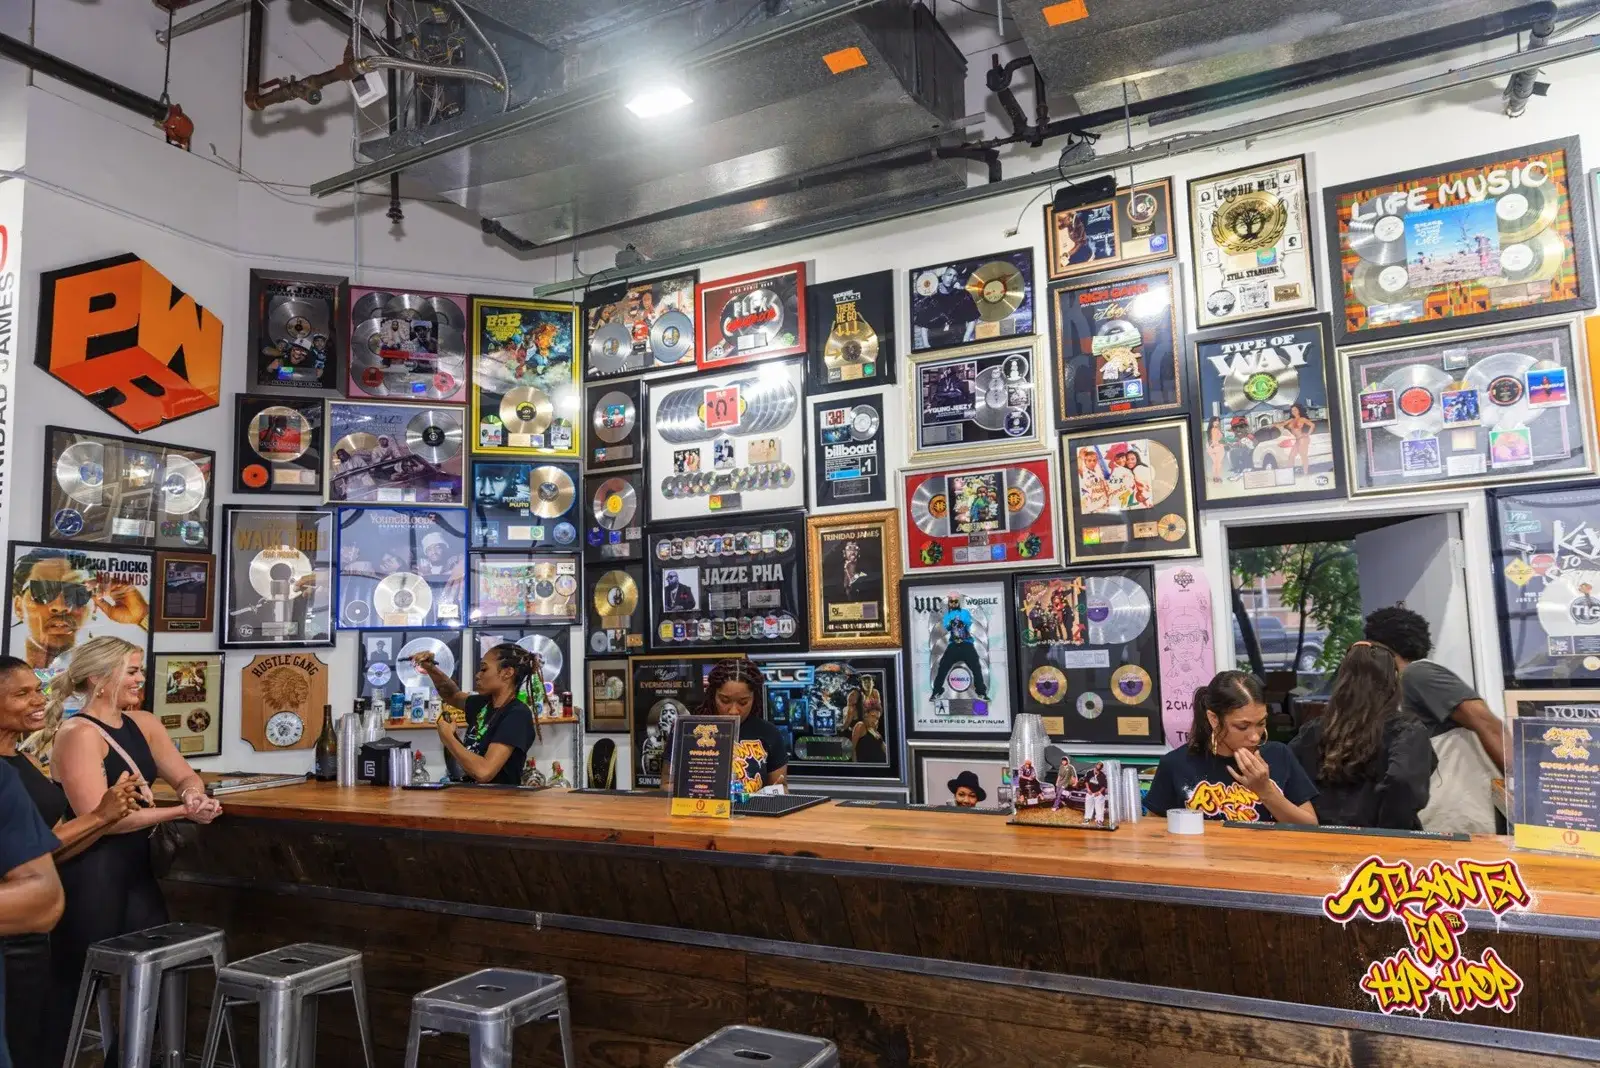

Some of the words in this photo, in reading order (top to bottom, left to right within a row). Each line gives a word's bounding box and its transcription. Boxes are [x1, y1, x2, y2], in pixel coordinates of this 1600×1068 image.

[1351, 186, 1430, 221] LIFE
[1438, 161, 1548, 204] MUSIC
[1079, 290, 1109, 304] RICH
[1111, 283, 1148, 299] GANG
[734, 297, 768, 317] FLEX
[836, 302, 856, 313] THERE
[836, 313, 846, 323] HE
[847, 311, 857, 322] GO
[1221, 338, 1267, 354] TYPE
[1270, 334, 1295, 346] OF
[1207, 342, 1312, 376] WAY
[928, 405, 950, 414] YOUNG
[825, 440, 877, 457] billboard
[823, 532, 855, 541] TRINIDAD
[69, 554, 106, 571] WAKA
[108, 557, 148, 573] FLOCKA
[1561, 555, 1581, 570] TO
[96, 571, 110, 583] NO
[113, 572, 148, 586] HANDS
[701, 565, 748, 586] JAZZE
[752, 563, 784, 582] PHA
[966, 597, 998, 606] WOBBLE
[1572, 604, 1600, 616] TIG
[252, 654, 291, 678] HUSTLE
[293, 655, 319, 676] GANG
[763, 669, 812, 682] TLC
[1552, 708, 1600, 719] YOUN
[1188, 780, 1262, 815] ATLAN
